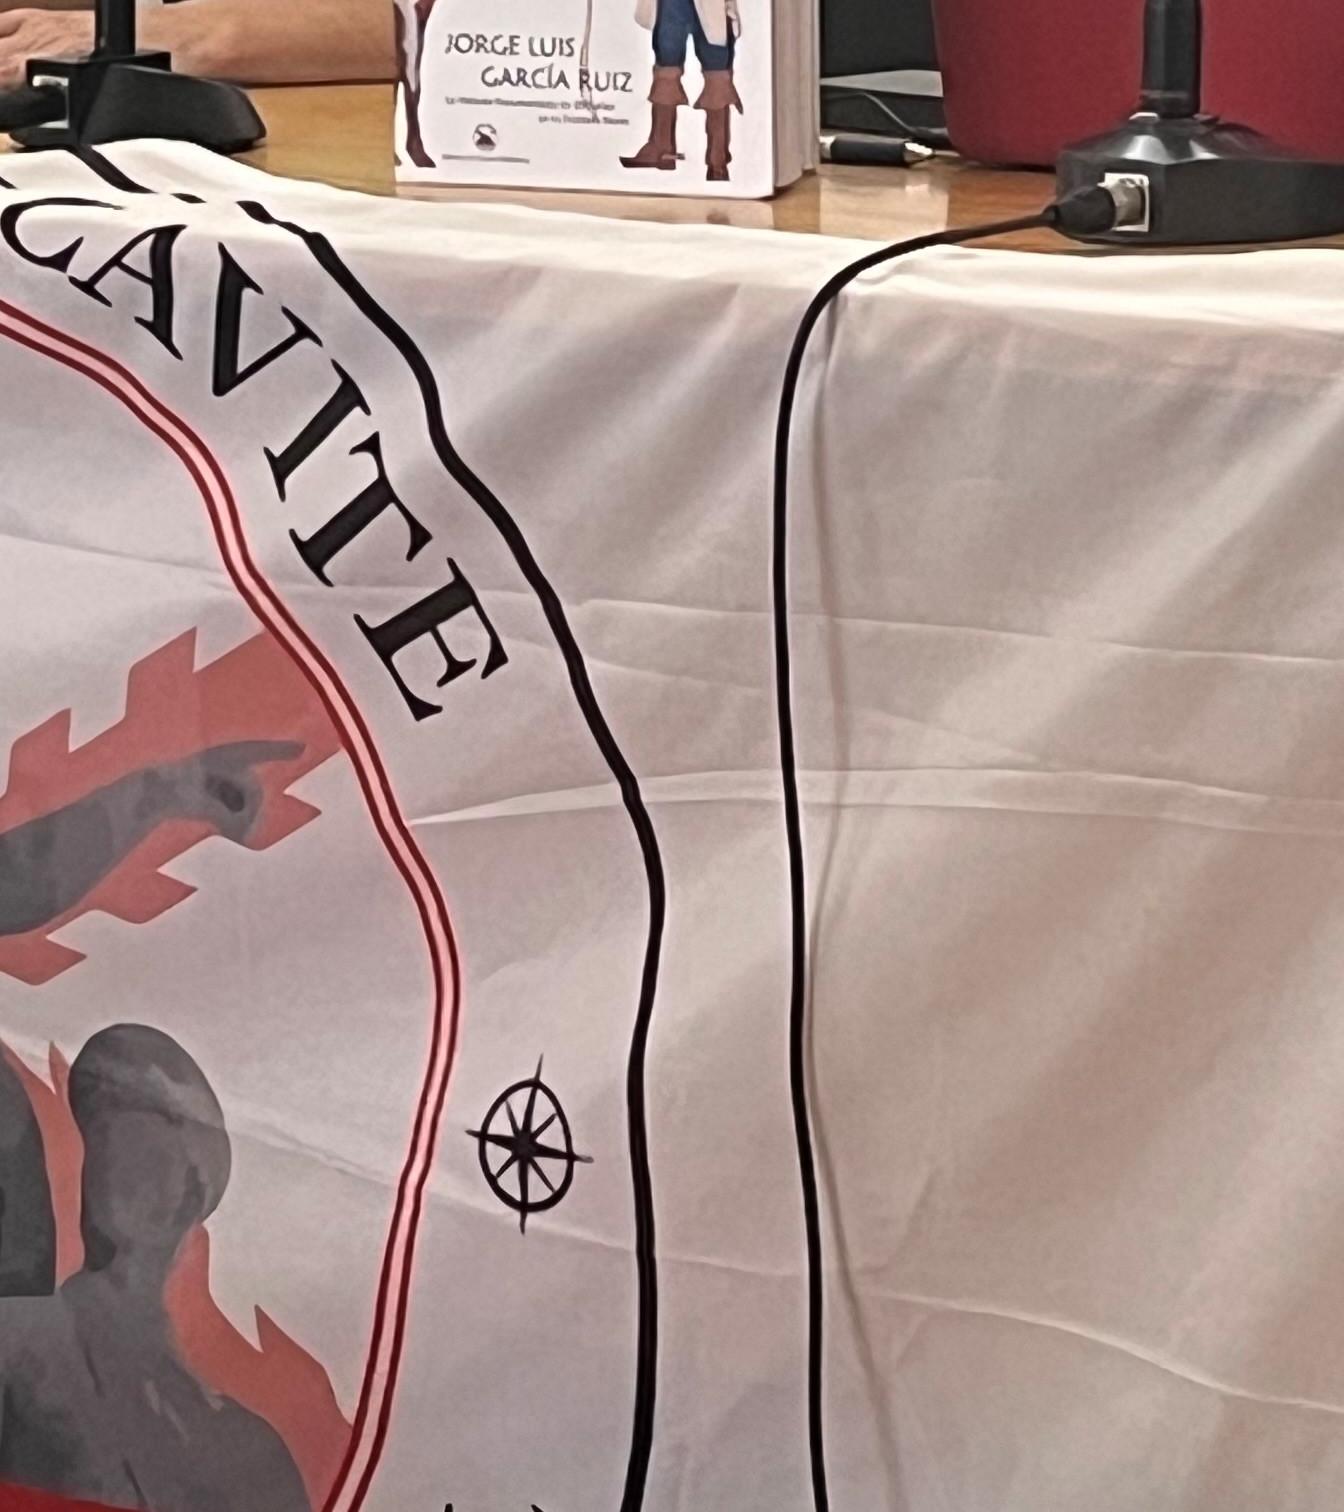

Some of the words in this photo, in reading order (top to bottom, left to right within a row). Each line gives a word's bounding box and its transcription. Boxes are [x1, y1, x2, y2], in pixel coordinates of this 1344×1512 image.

[444, 33, 520, 56] JORGE
[528, 36, 575, 58] LUIS
[480, 62, 571, 90] GARCÍA
[578, 67, 633, 93] RUIZ
[0, 196, 509, 722] CAVITE
